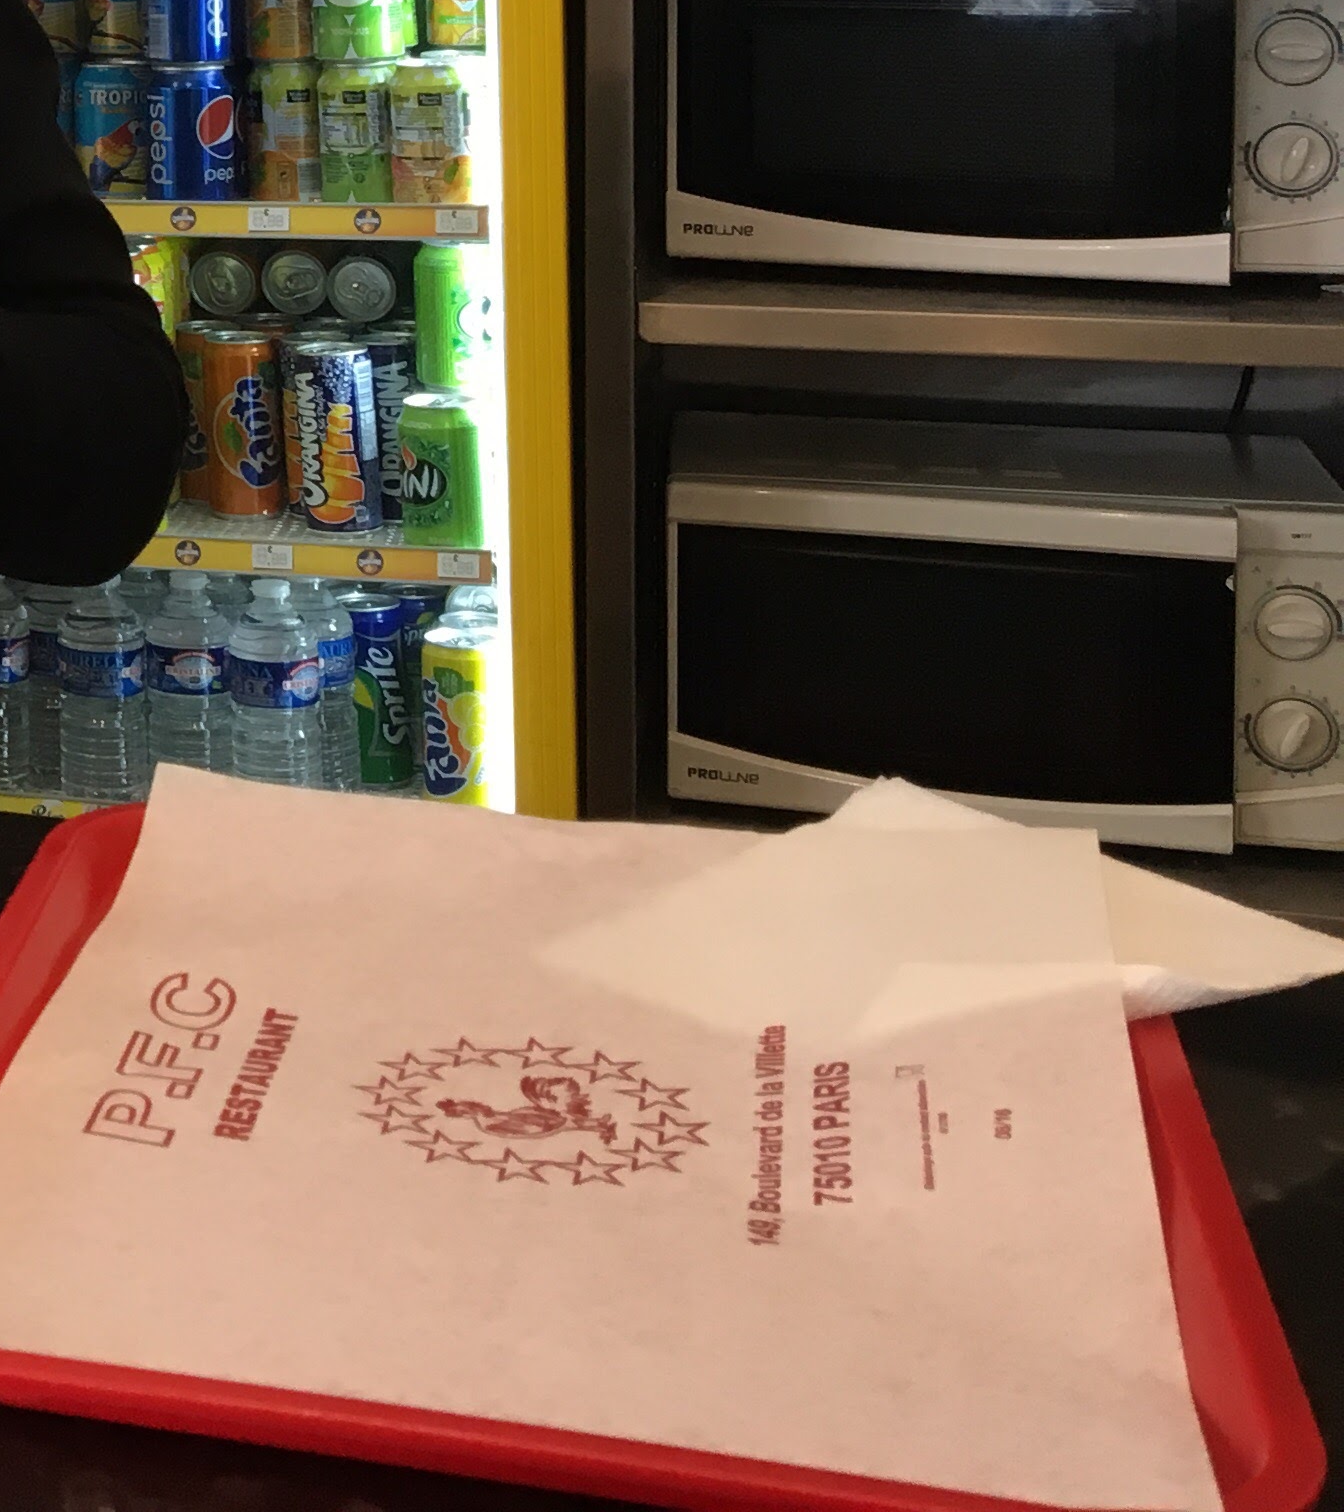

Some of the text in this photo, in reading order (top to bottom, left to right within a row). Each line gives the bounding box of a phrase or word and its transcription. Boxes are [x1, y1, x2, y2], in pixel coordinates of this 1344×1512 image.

[146, 93, 174, 186] pepsi
[203, 166, 235, 185] pep
[229, 375, 281, 488] Fanta
[294, 371, 328, 508] ORANGINA
[367, 645, 408, 746] Sprite
[422, 678, 469, 798] Fanta
[212, 1006, 300, 1142] RESTAURANT
[754, 1024, 787, 1079] Villette
[754, 1099, 784, 1122] de
[812, 1060, 854, 1207] 75010 PARIS
[747, 1125, 784, 1215] Boulevard
